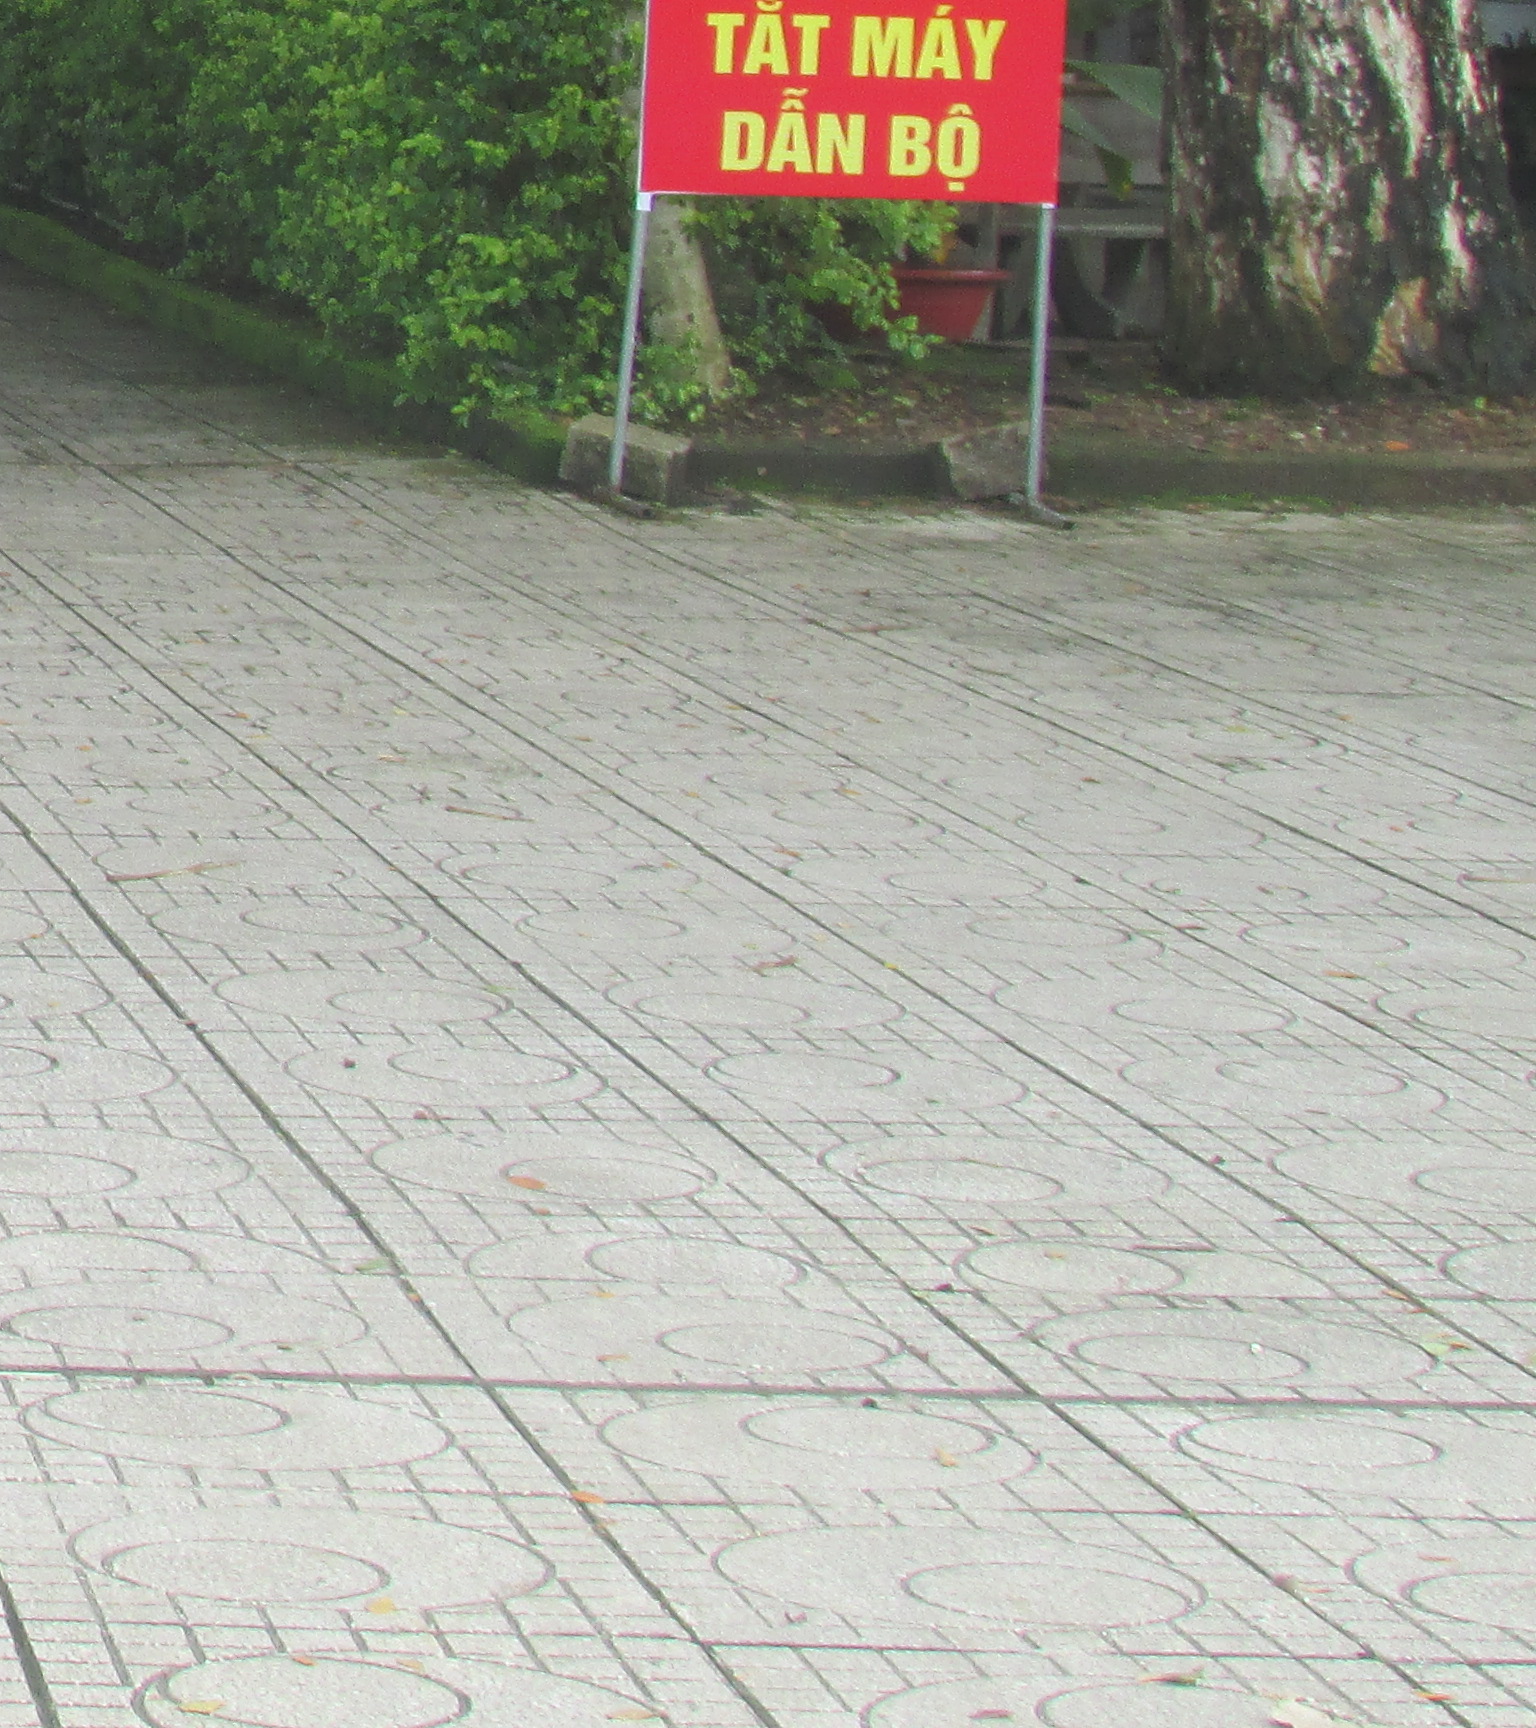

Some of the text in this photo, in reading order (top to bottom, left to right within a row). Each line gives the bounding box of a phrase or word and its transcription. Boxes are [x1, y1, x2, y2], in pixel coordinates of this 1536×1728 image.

[851, 5, 1006, 80] MÁY
[720, 88, 981, 192] DẪN BỘ
